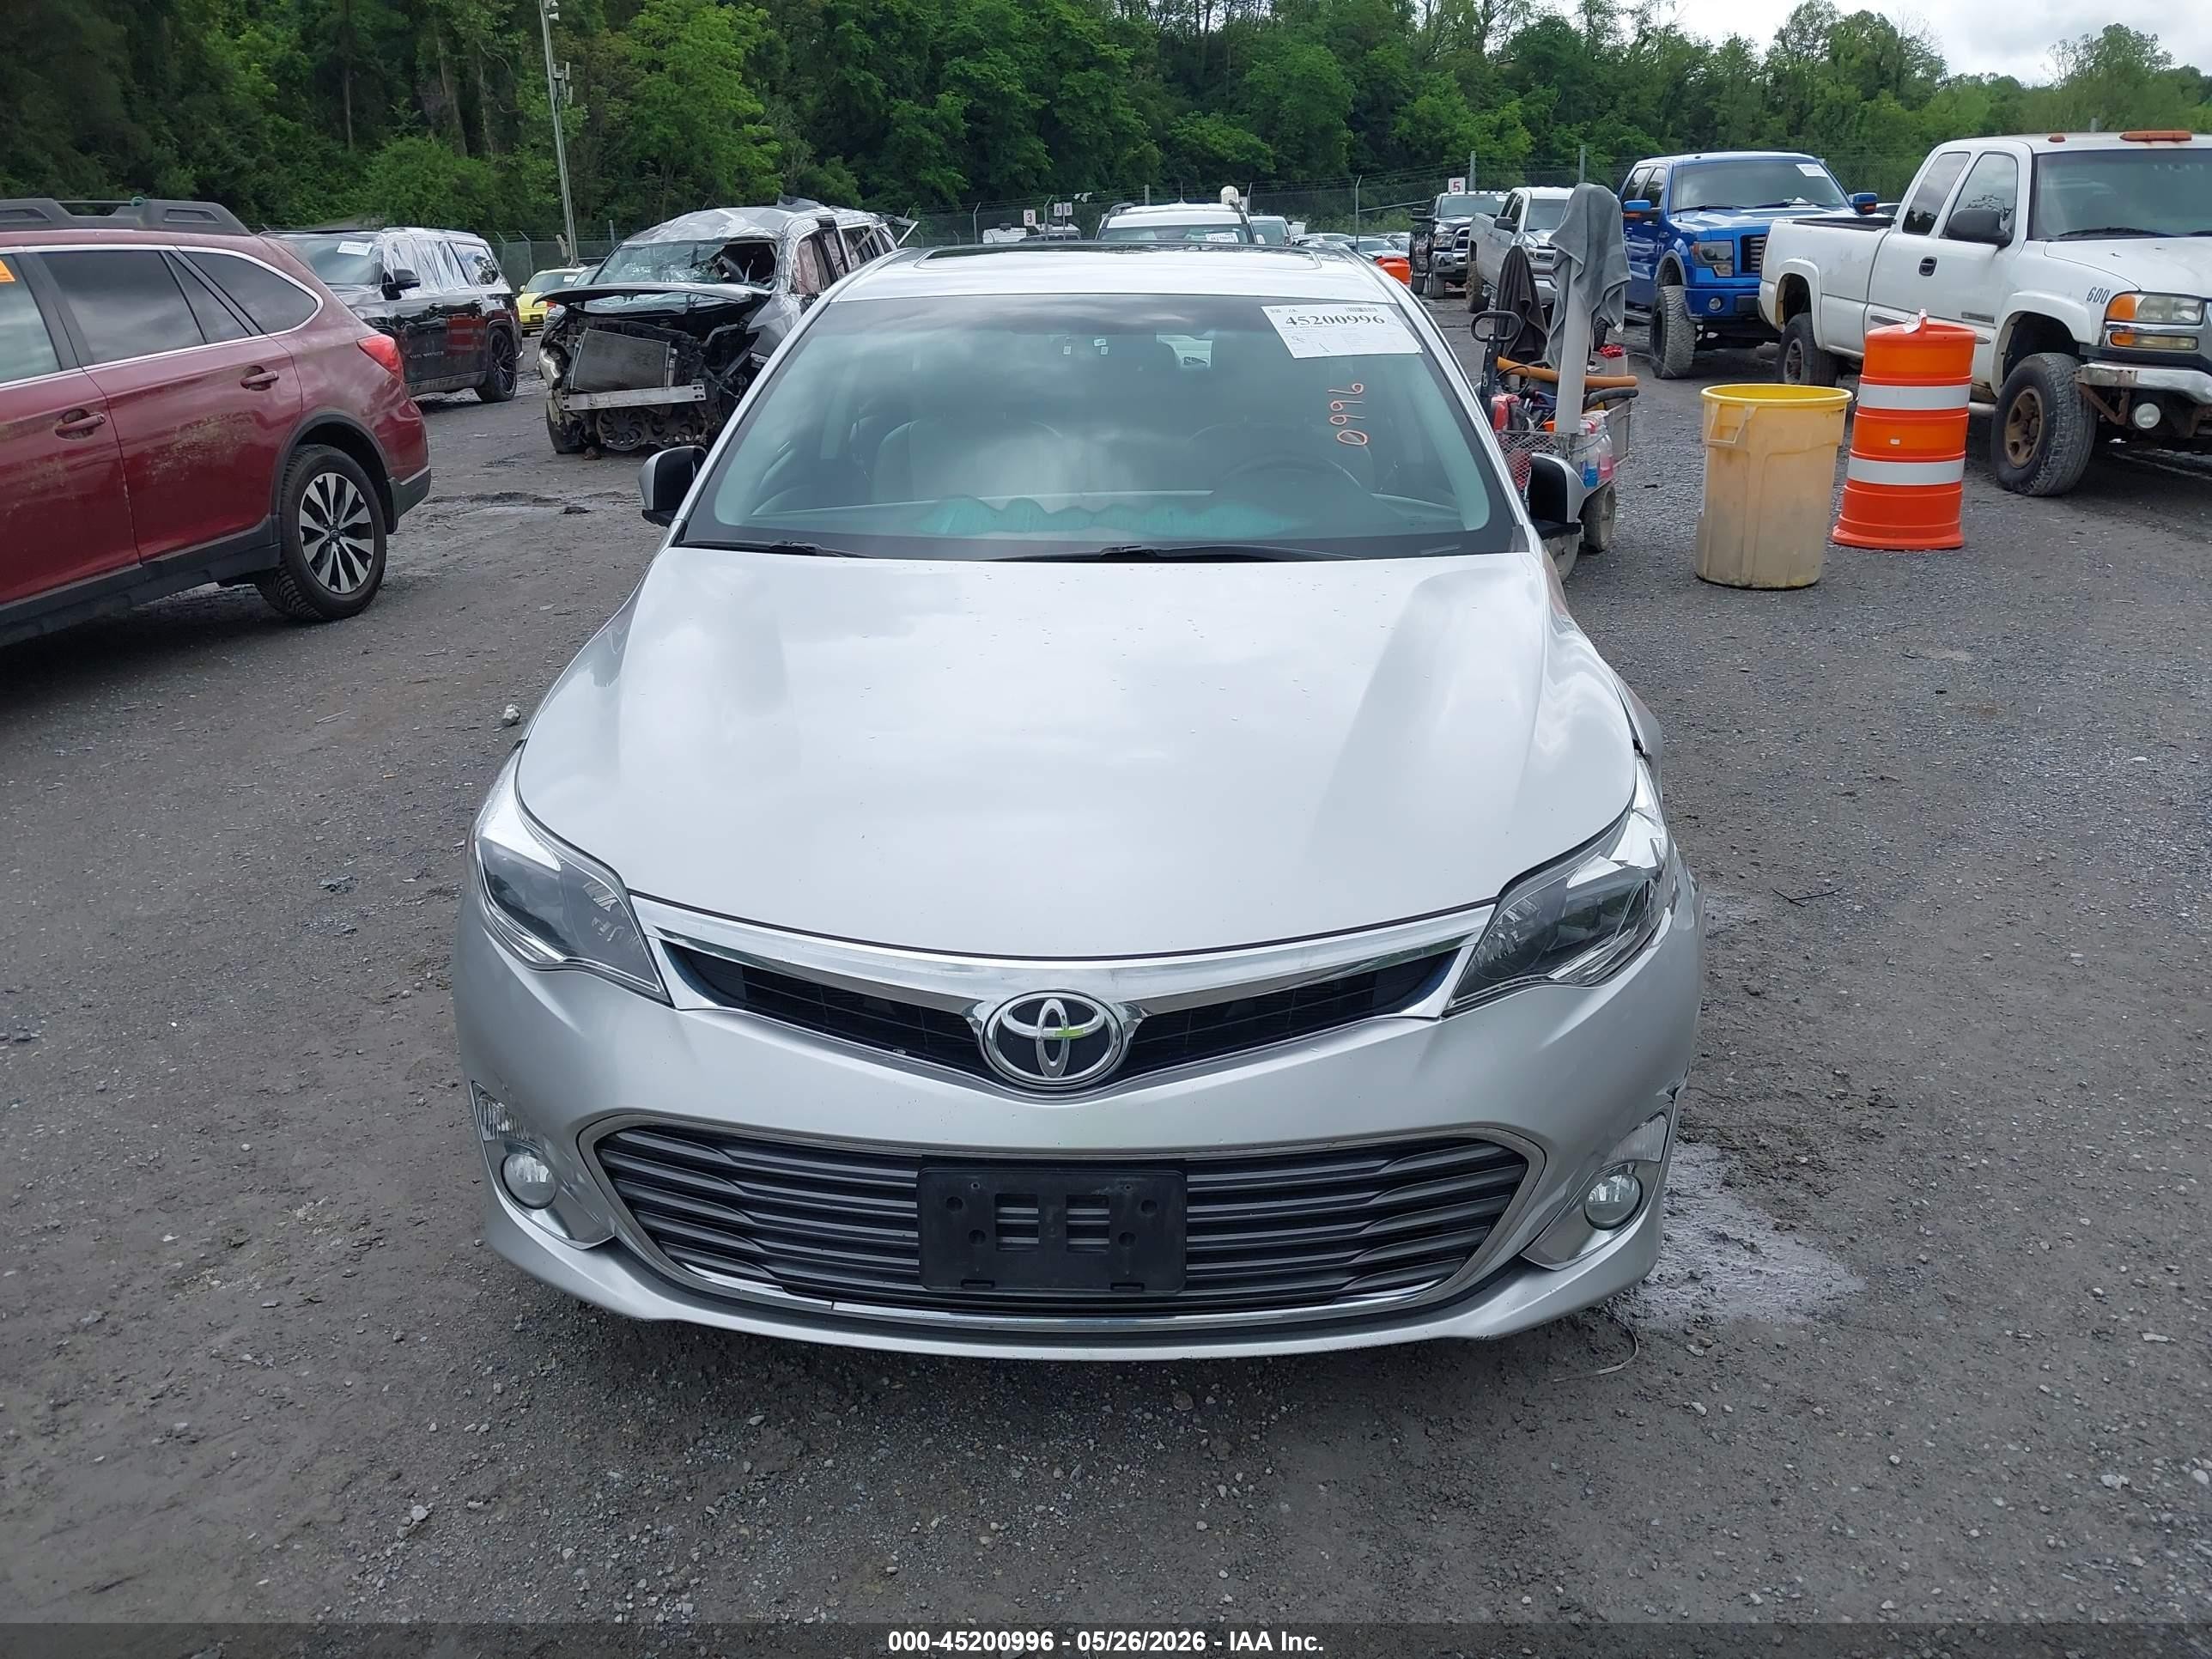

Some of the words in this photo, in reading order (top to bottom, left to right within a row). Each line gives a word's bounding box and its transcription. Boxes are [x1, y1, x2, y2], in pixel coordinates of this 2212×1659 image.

[1453, 181, 1461, 192] 5
[1027, 212, 1033, 223] 3
[2087, 286, 2111, 305] 600
[1285, 315, 1385, 325] 45200996
[1328, 383, 1368, 445] 0996
